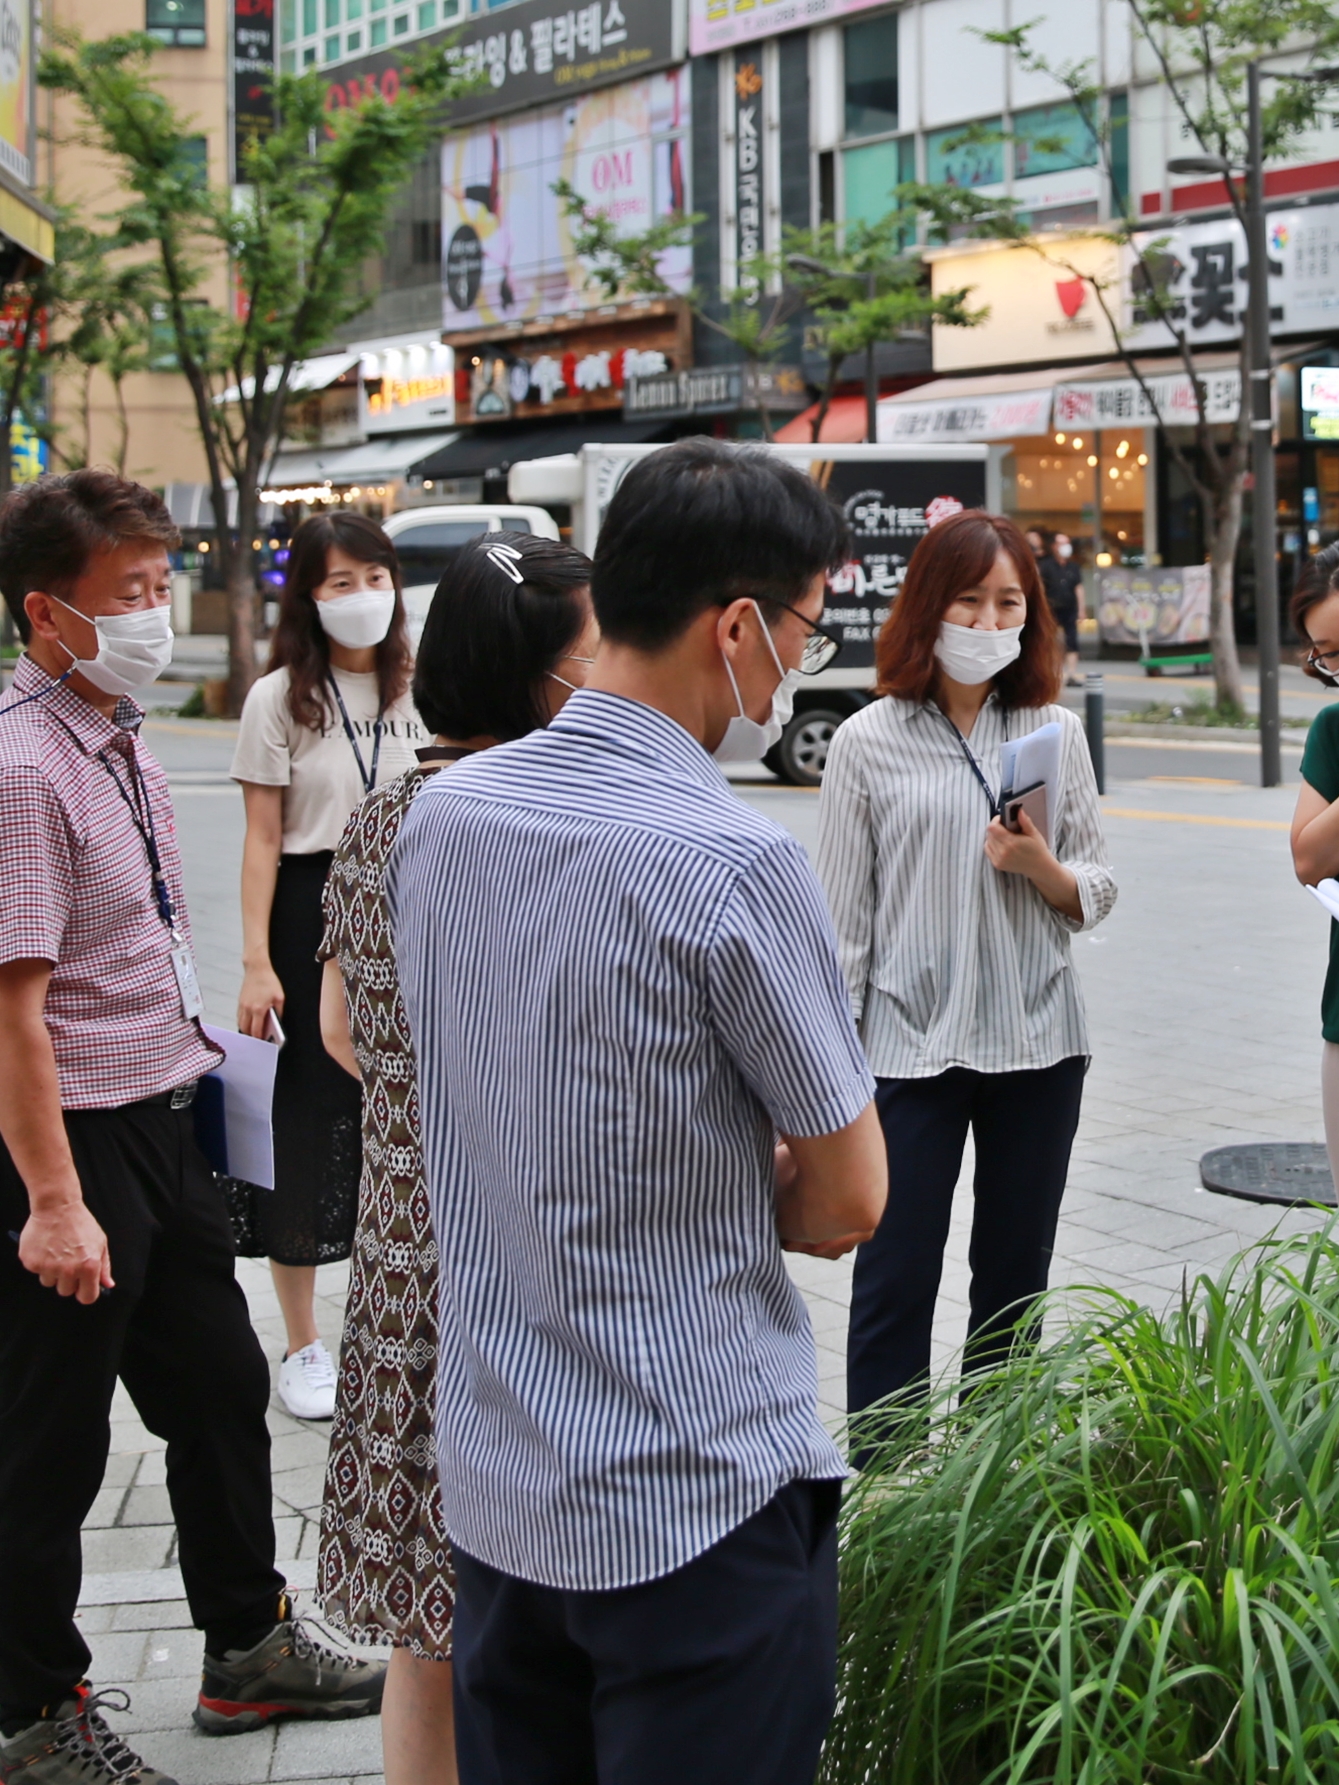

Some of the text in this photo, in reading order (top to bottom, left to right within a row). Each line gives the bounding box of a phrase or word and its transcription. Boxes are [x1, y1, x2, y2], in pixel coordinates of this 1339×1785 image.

[530, 0, 627, 76] 필라테스
[591, 151, 634, 193] OM
[843, 626, 871, 642] FAX
